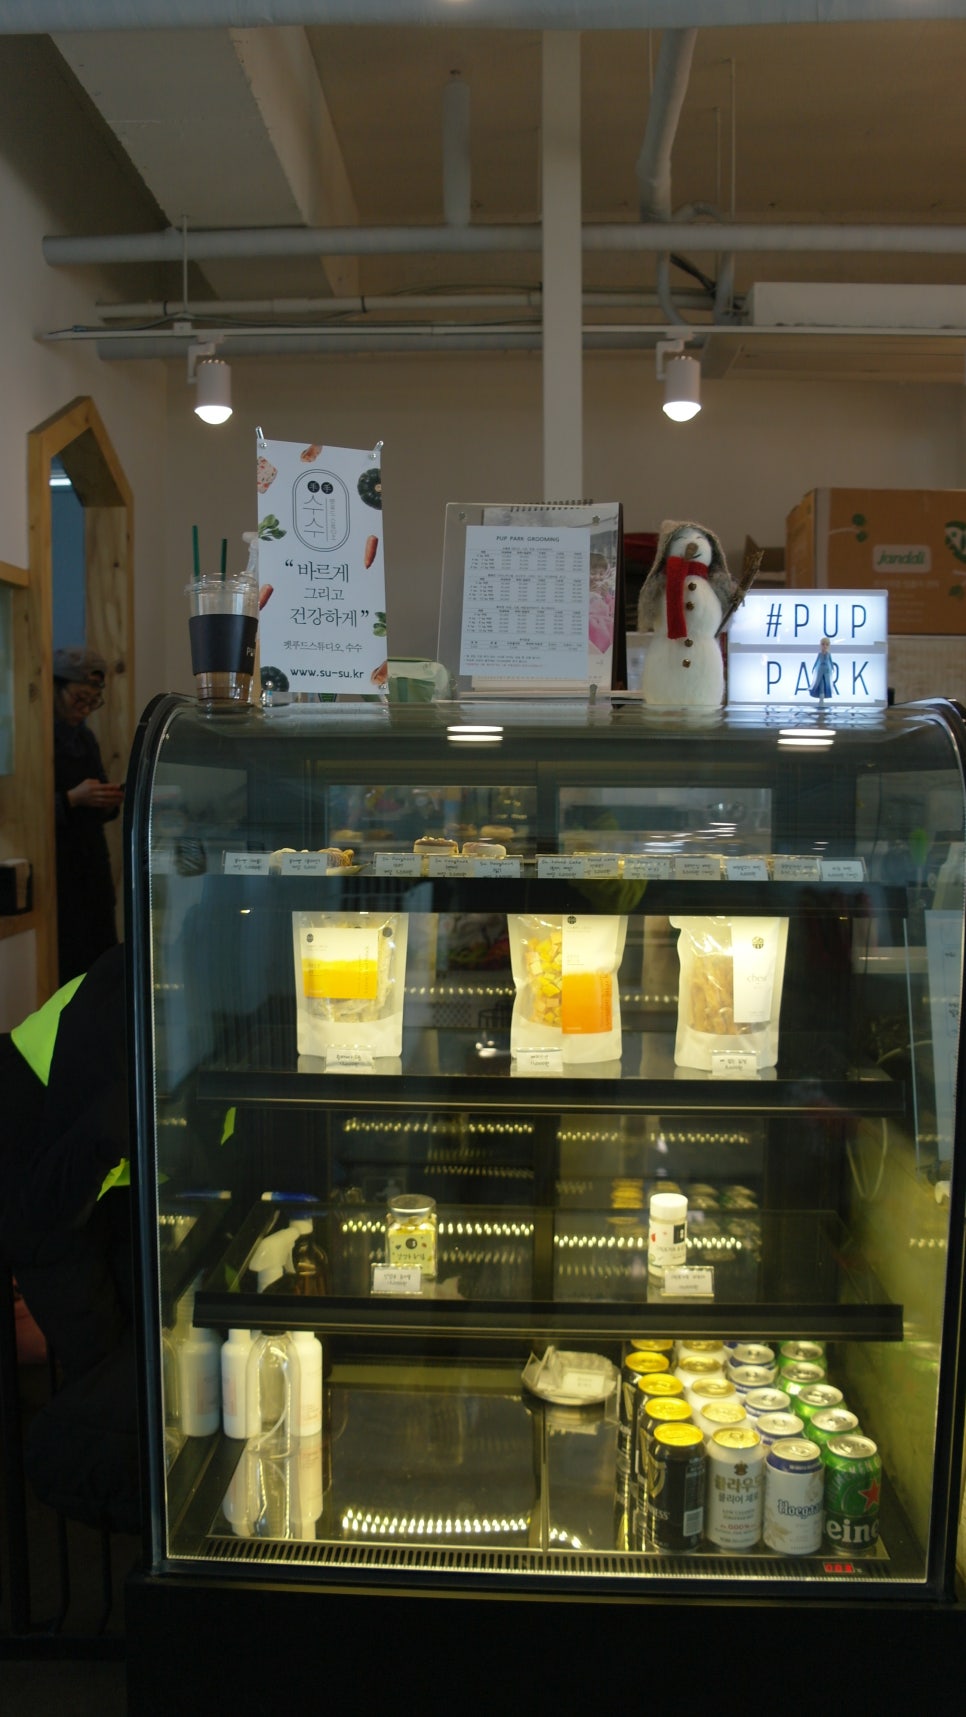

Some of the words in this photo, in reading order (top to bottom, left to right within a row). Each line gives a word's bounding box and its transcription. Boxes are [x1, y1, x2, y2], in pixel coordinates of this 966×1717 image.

[303, 586, 345, 601] 그리고
[766, 603, 867, 638] #PUP
[290, 668, 364, 679] www.su-su.kr
